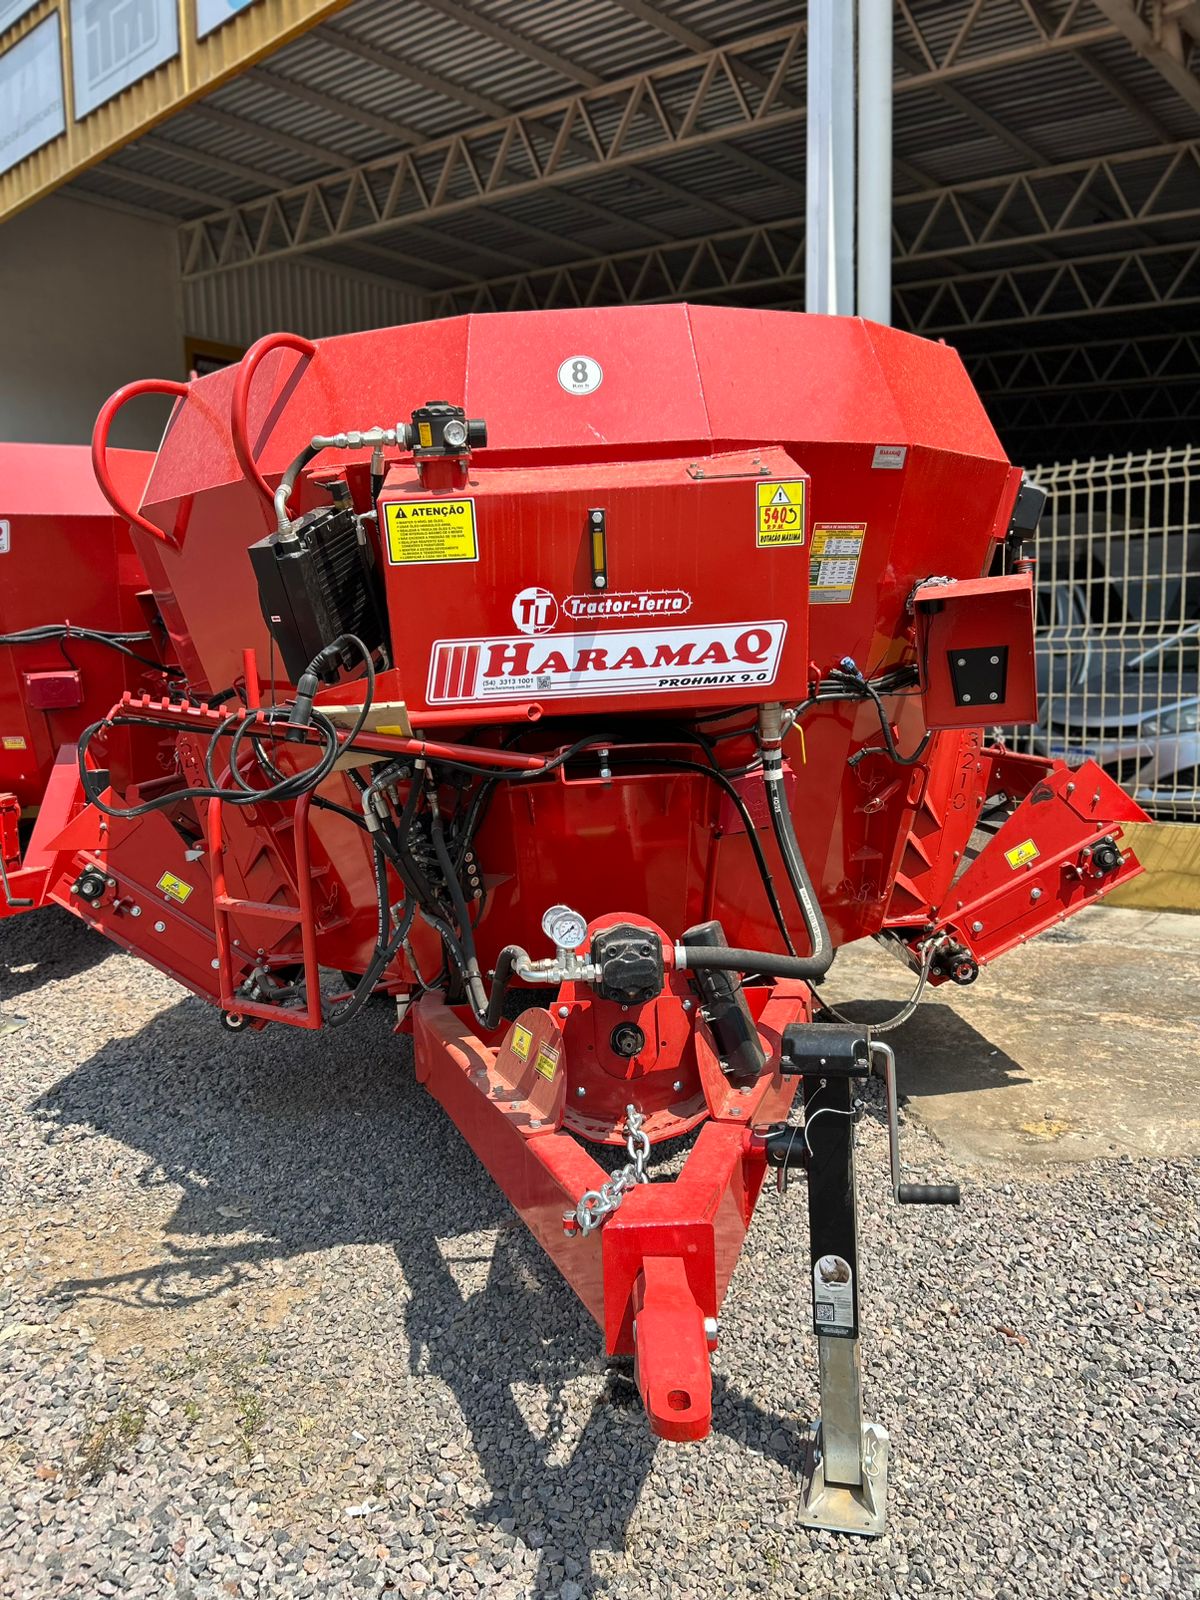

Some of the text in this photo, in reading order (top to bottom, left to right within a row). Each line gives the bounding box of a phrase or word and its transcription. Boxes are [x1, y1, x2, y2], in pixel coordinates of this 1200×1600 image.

[572, 360, 588, 383] 8
[411, 505, 464, 517] ATENÇÃO
[764, 506, 787, 524] 540
[760, 532, 800, 543] ROTAÇÃO MÁXIMA
[570, 596, 682, 614] Tractor-Terra
[482, 628, 773, 676] HARAMAQ
[482, 679, 496, 687] (54)
[658, 672, 768, 687] PROHMIX 9.0
[952, 732, 978, 810] 3 2 1 0
